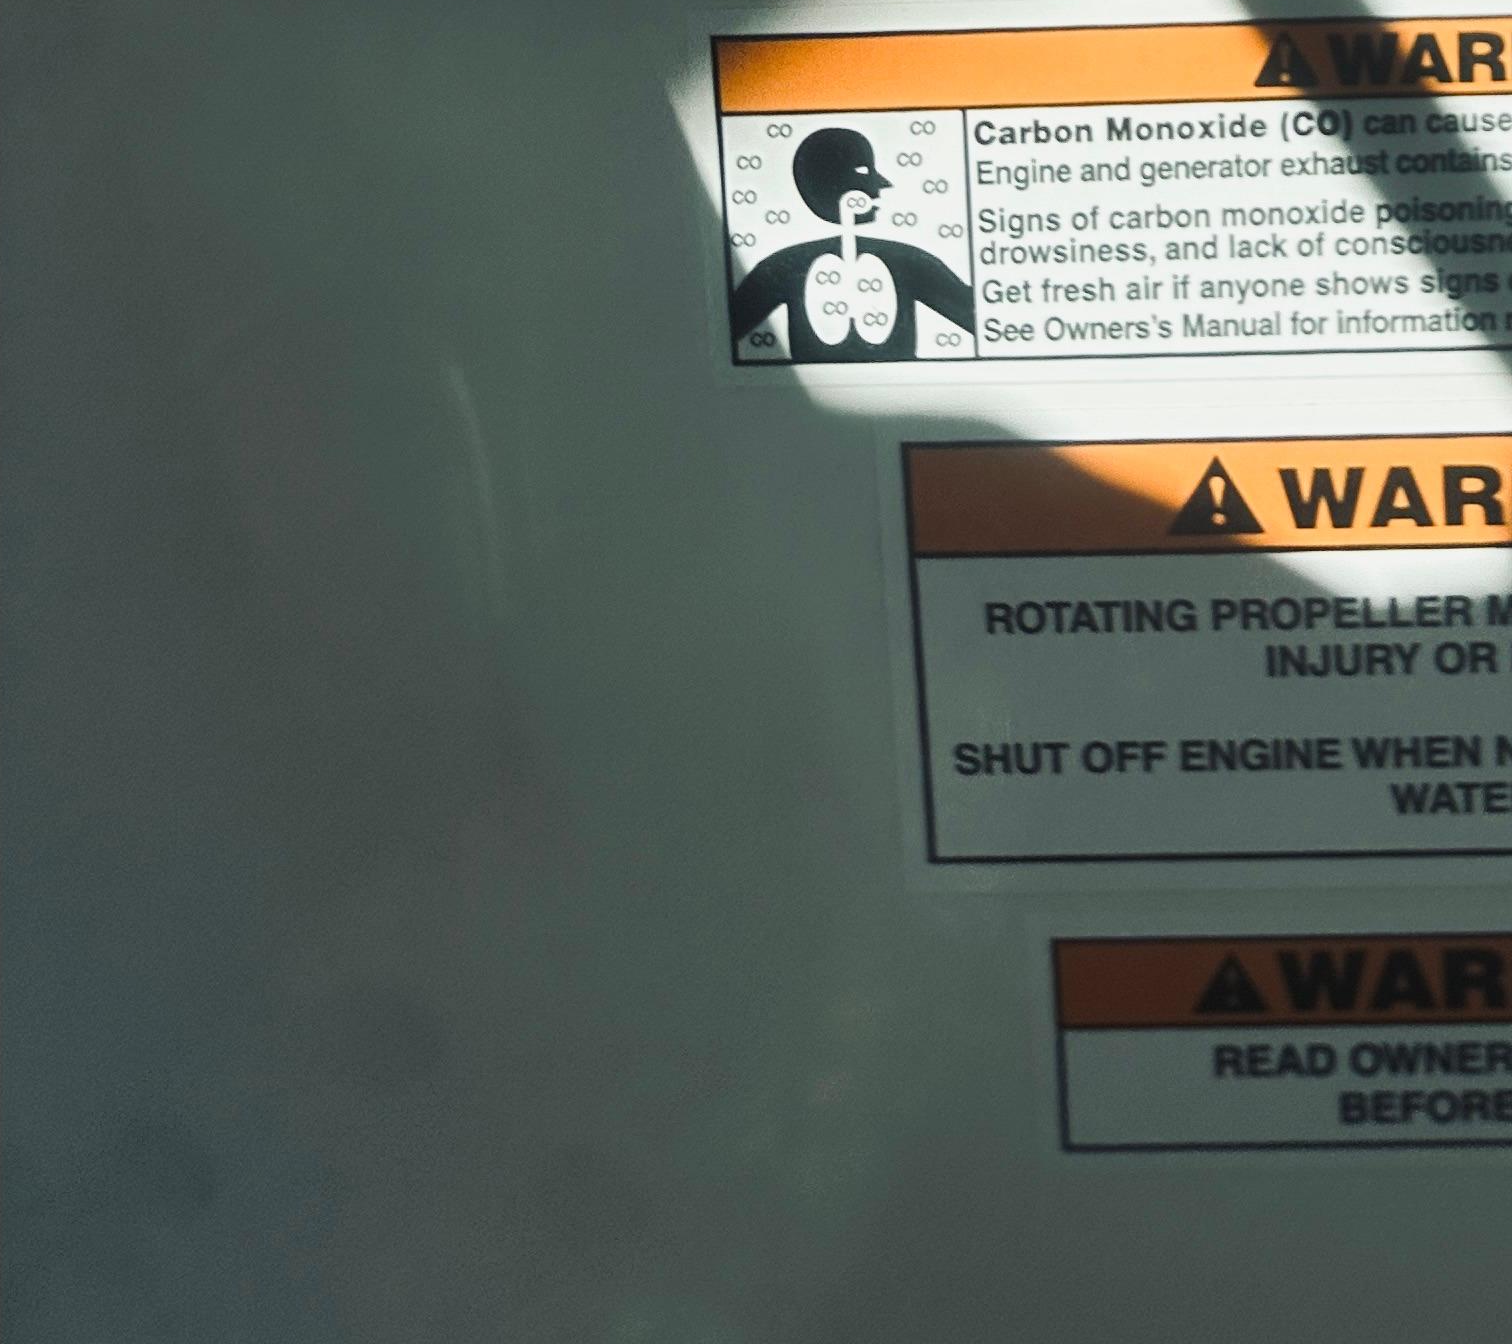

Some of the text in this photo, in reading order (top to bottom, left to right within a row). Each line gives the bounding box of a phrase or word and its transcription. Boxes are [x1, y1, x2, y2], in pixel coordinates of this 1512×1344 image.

[767, 123, 791, 138] CO
[911, 121, 935, 134] CO
[974, 117, 1096, 146] Carbon
[1106, 114, 1268, 142] Monoxide
[1279, 110, 1352, 143] (CO)
[1365, 111, 1416, 136] can
[1430, 106, 1512, 134] cause
[738, 155, 761, 169] CO
[897, 152, 921, 166] CO
[977, 160, 1072, 192] Engine
[1080, 156, 1130, 184] and
[1139, 153, 1272, 186] generator
[1280, 150, 1388, 178] exhaust
[923, 179, 947, 193] CO
[733, 189, 756, 203] CO
[848, 195, 866, 208] CO
[765, 209, 789, 224] CO
[893, 212, 917, 226] CO
[979, 208, 1060, 240] Signs
[1070, 204, 1102, 232] of
[1109, 203, 1208, 231] carbon
[1221, 201, 1366, 228] monoxide
[939, 222, 962, 238] CO
[731, 232, 755, 246] CO
[980, 238, 1157, 268] drowsiness,
[1165, 234, 1218, 262] and
[1228, 233, 1286, 260] lack
[1296, 232, 1327, 258] of
[816, 269, 839, 284] CO
[858, 277, 882, 291] CO
[982, 277, 1032, 306] Get
[1040, 275, 1115, 303] fresh
[1125, 274, 1164, 301] air
[1173, 273, 1192, 300] if
[1200, 273, 1306, 306] anyone
[1315, 271, 1409, 297] shows
[1419, 267, 1499, 298] signs
[824, 300, 847, 314] CO
[863, 311, 887, 326] CO
[984, 317, 1036, 343] See
[1043, 313, 1173, 342] Owners's
[1181, 312, 1280, 339] Manual
[1290, 311, 1327, 337] for
[1336, 307, 1496, 334] information
[750, 331, 774, 346] CO
[937, 331, 961, 345] CO
[984, 596, 1198, 636] ROTATING
[1211, 594, 1473, 632] PROPELLER
[1265, 641, 1418, 680] INJURY
[1435, 640, 1496, 675] OR
[953, 740, 1069, 777] SHUT
[1083, 739, 1167, 774] OFF
[1179, 736, 1342, 773] ENGINE
[1353, 734, 1480, 770] WHEN
[1214, 1043, 1336, 1078] READ
